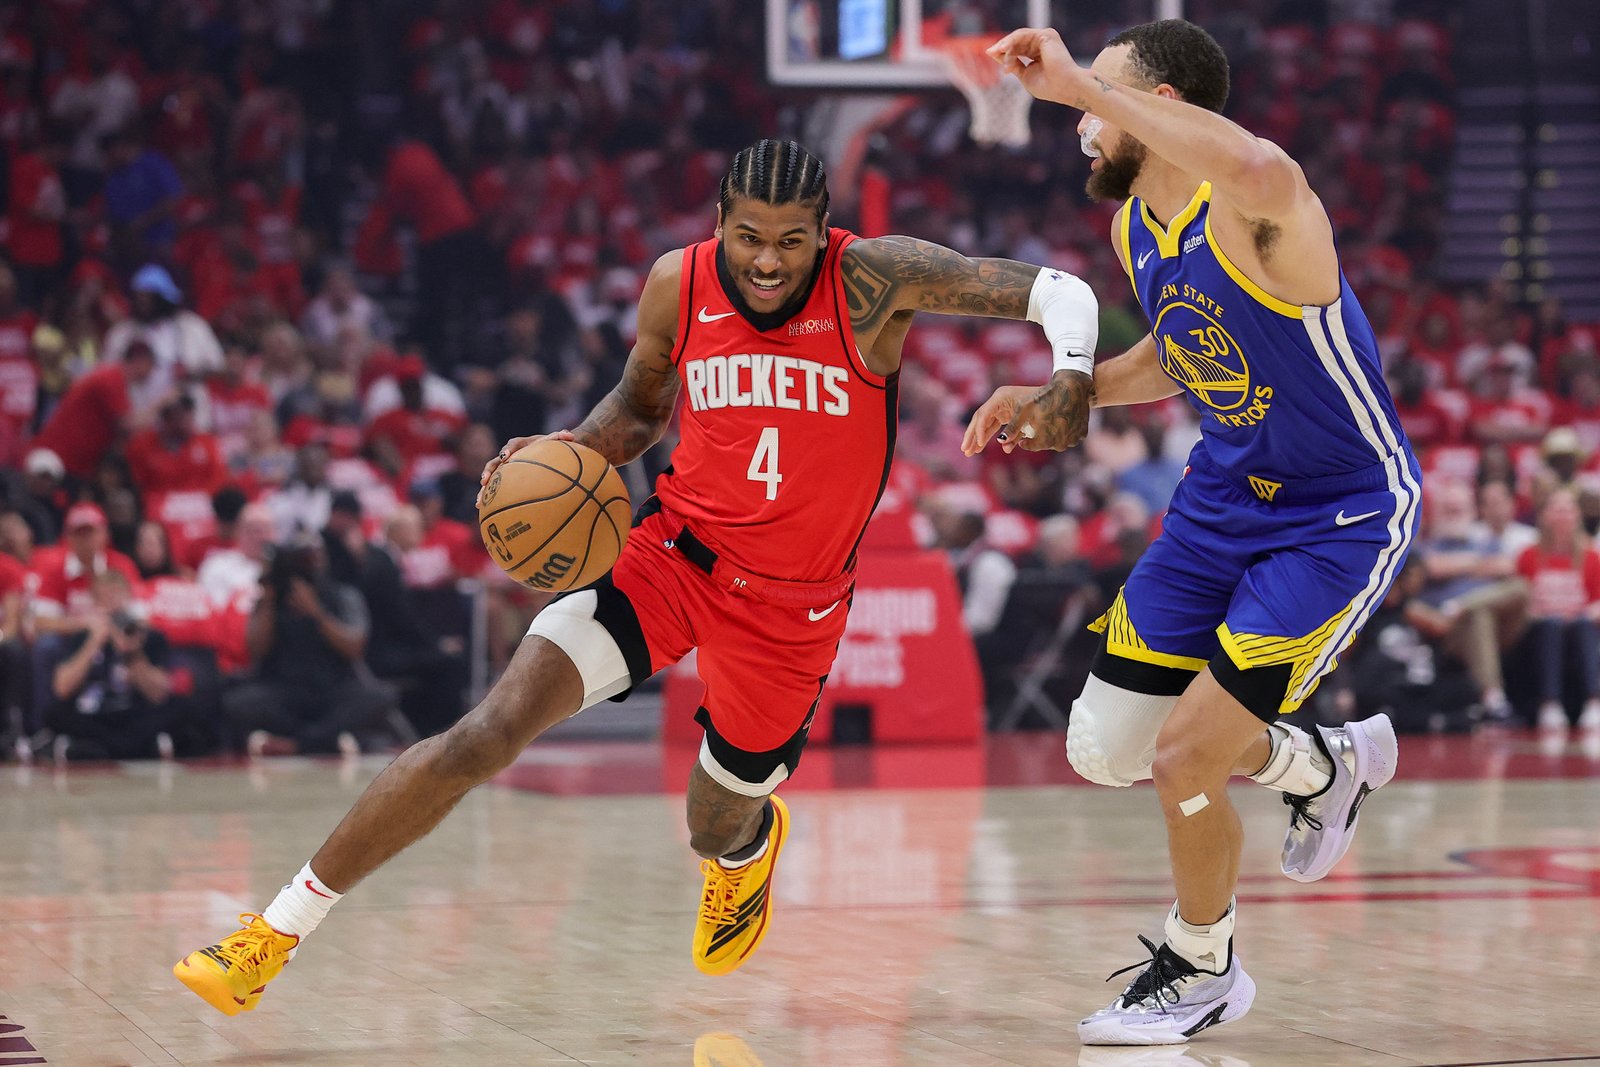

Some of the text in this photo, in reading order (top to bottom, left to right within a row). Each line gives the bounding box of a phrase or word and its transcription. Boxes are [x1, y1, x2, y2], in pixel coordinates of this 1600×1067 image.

[1183, 284, 1225, 318] STATE
[789, 318, 833, 330] MEMORIAL
[789, 322, 834, 337] HERMANN
[1188, 326, 1230, 358] 30
[686, 353, 849, 417] ROCKETS
[747, 427, 783, 501] 4
